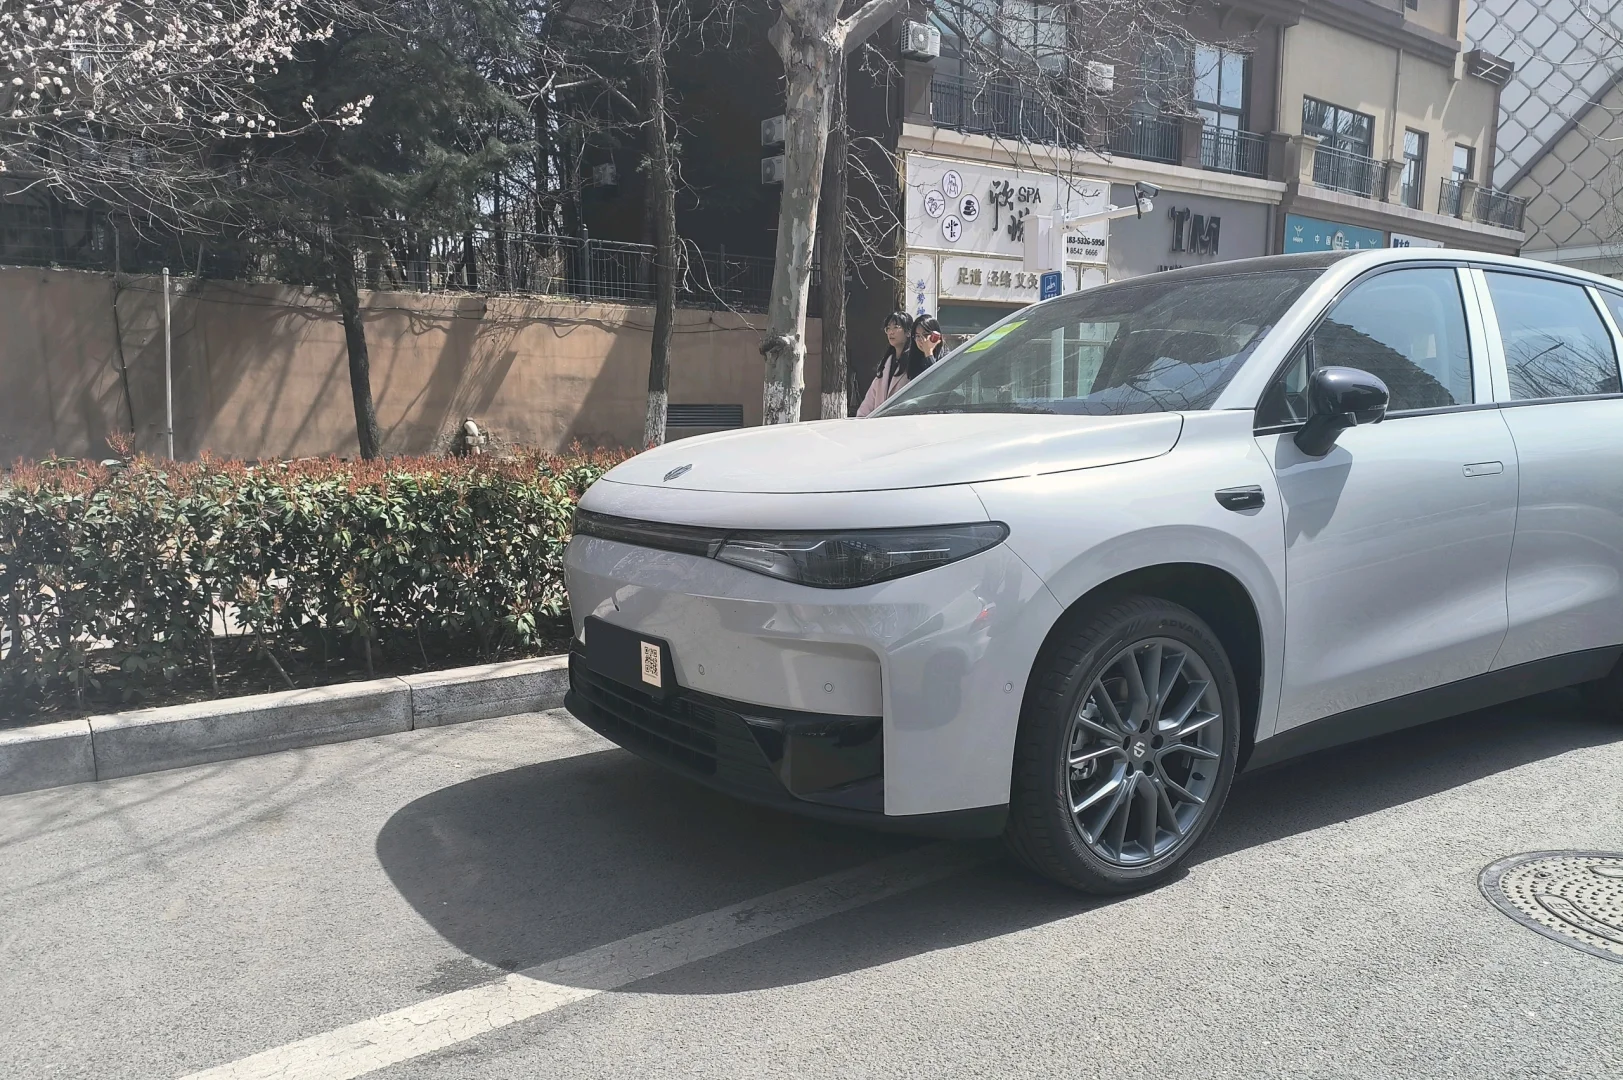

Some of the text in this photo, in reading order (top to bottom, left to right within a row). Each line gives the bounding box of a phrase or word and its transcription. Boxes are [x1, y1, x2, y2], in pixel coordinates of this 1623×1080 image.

[1017, 186, 1042, 204] SPA
[957, 267, 1039, 290] 足道 经络 艾灸
[1160, 619, 1203, 640] ADVAN
